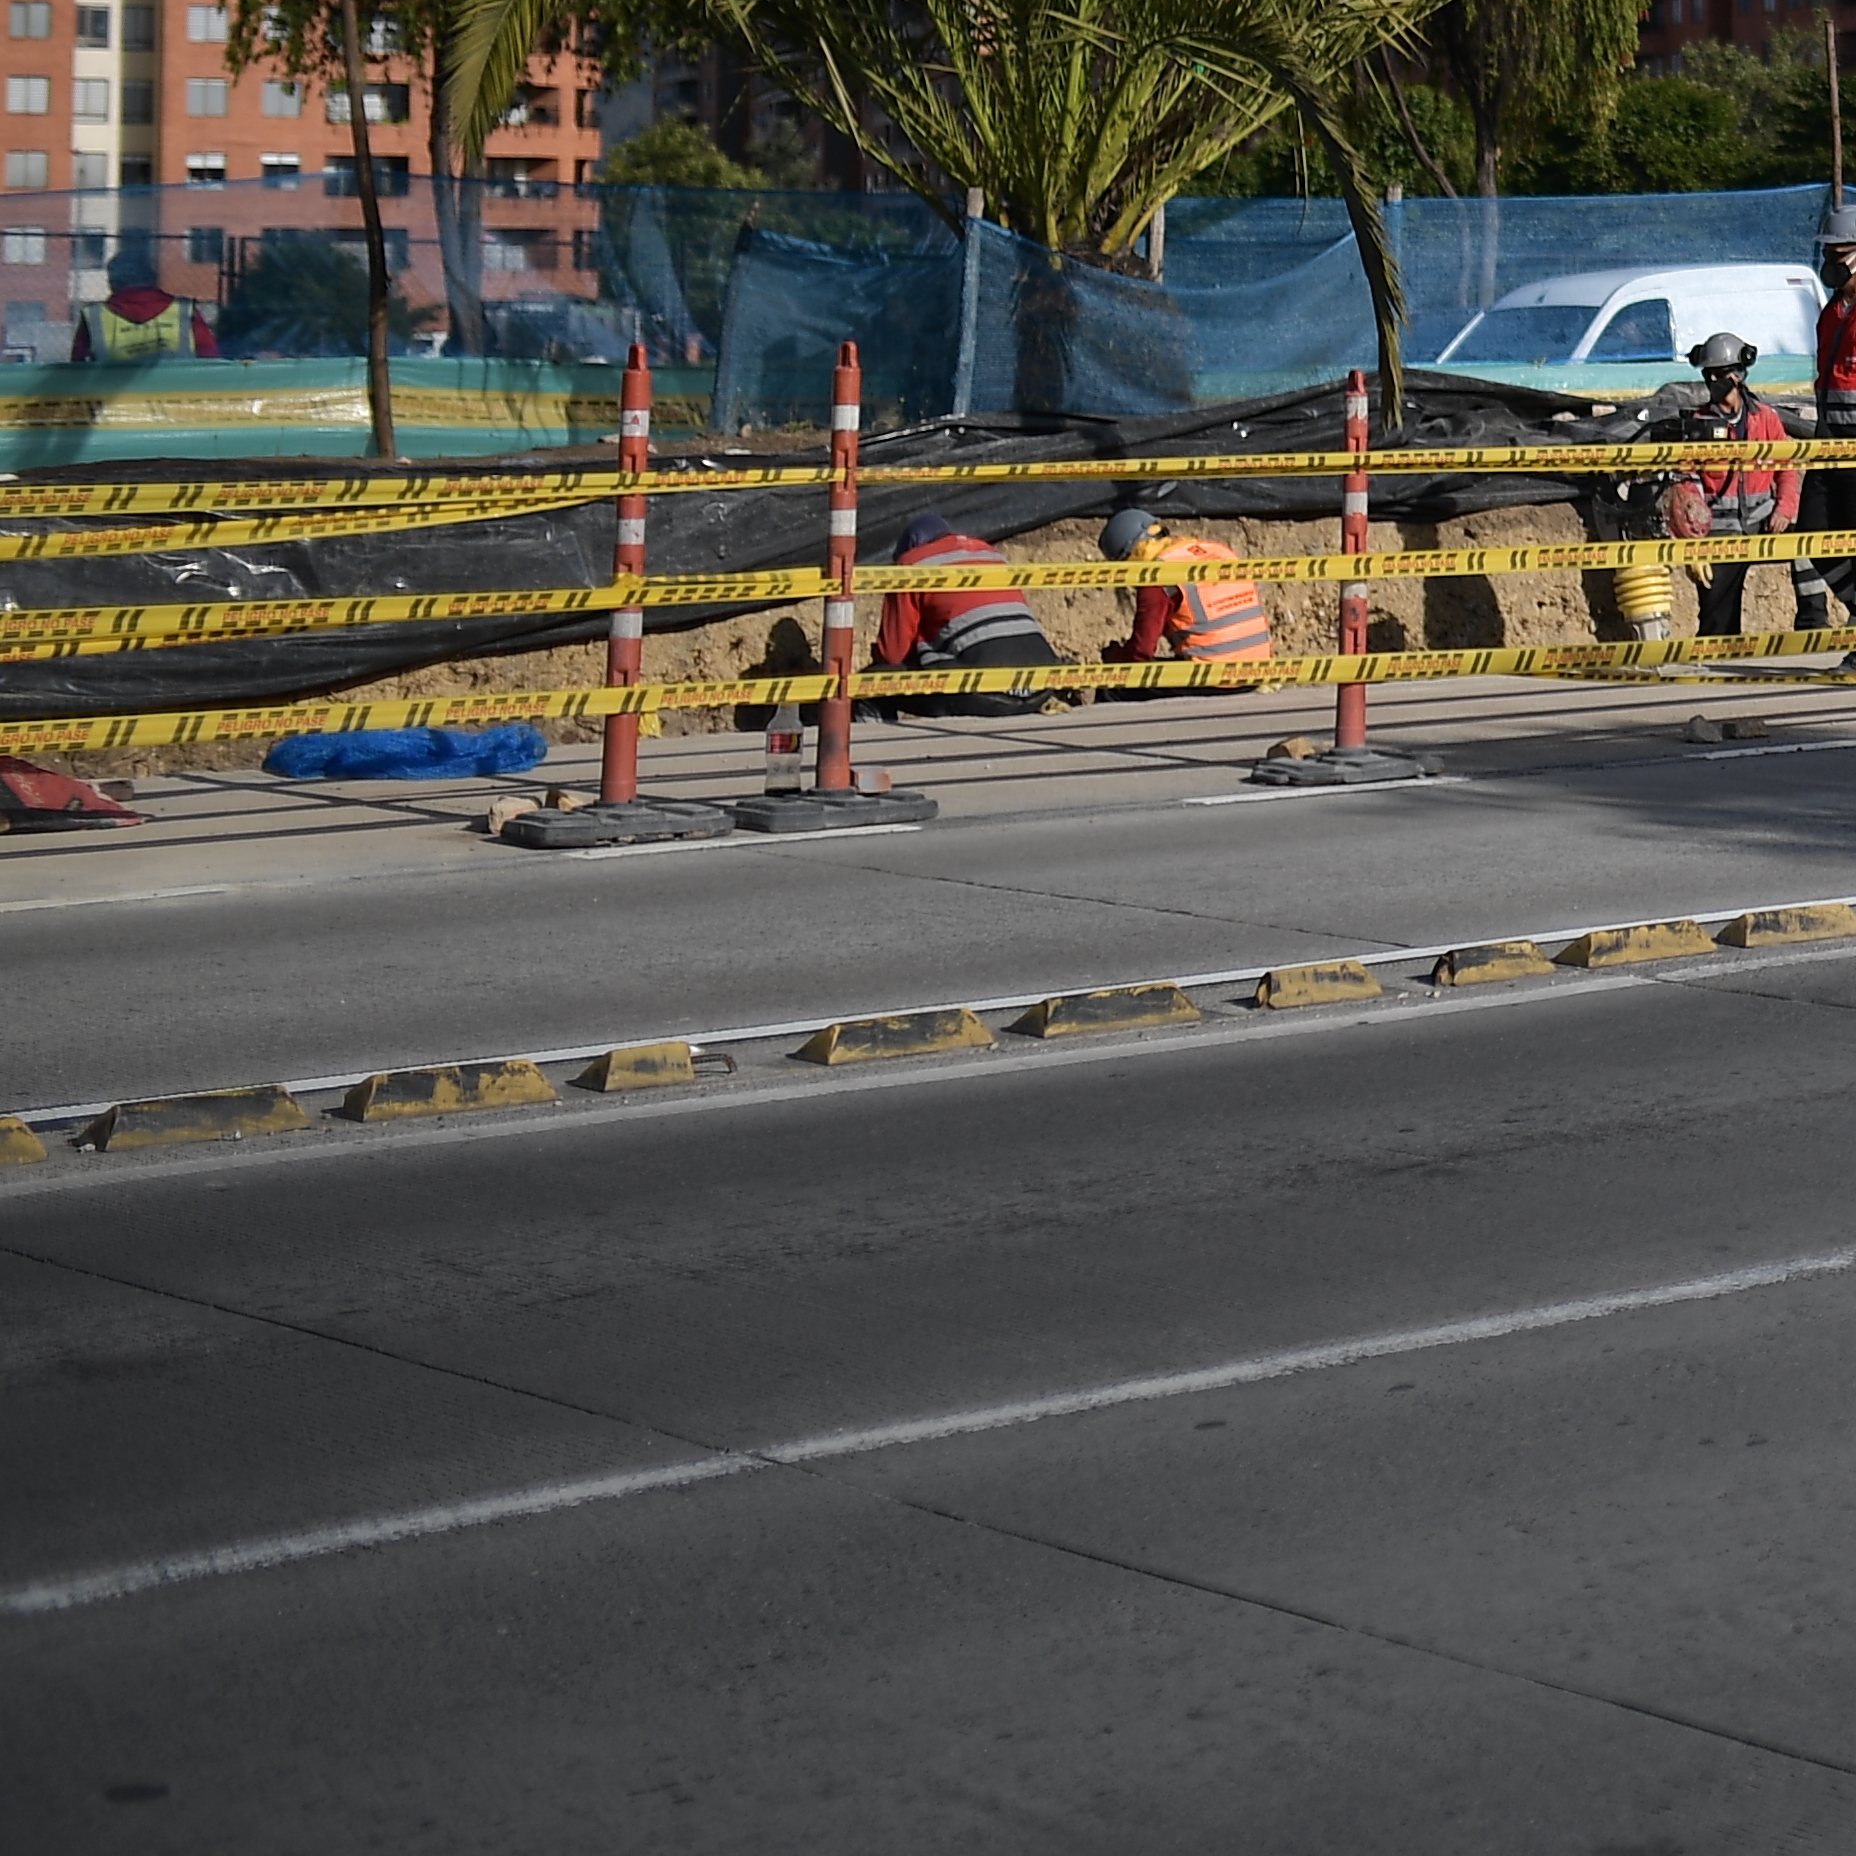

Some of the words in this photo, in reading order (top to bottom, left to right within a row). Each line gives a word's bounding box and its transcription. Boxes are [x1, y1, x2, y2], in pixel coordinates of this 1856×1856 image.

[63, 492, 93, 503] PASE
[64, 615, 97, 627] PASE
[216, 718, 271, 734] PELIGRO
[34, 731, 54, 742] NO
[57, 728, 91, 741] PASE
